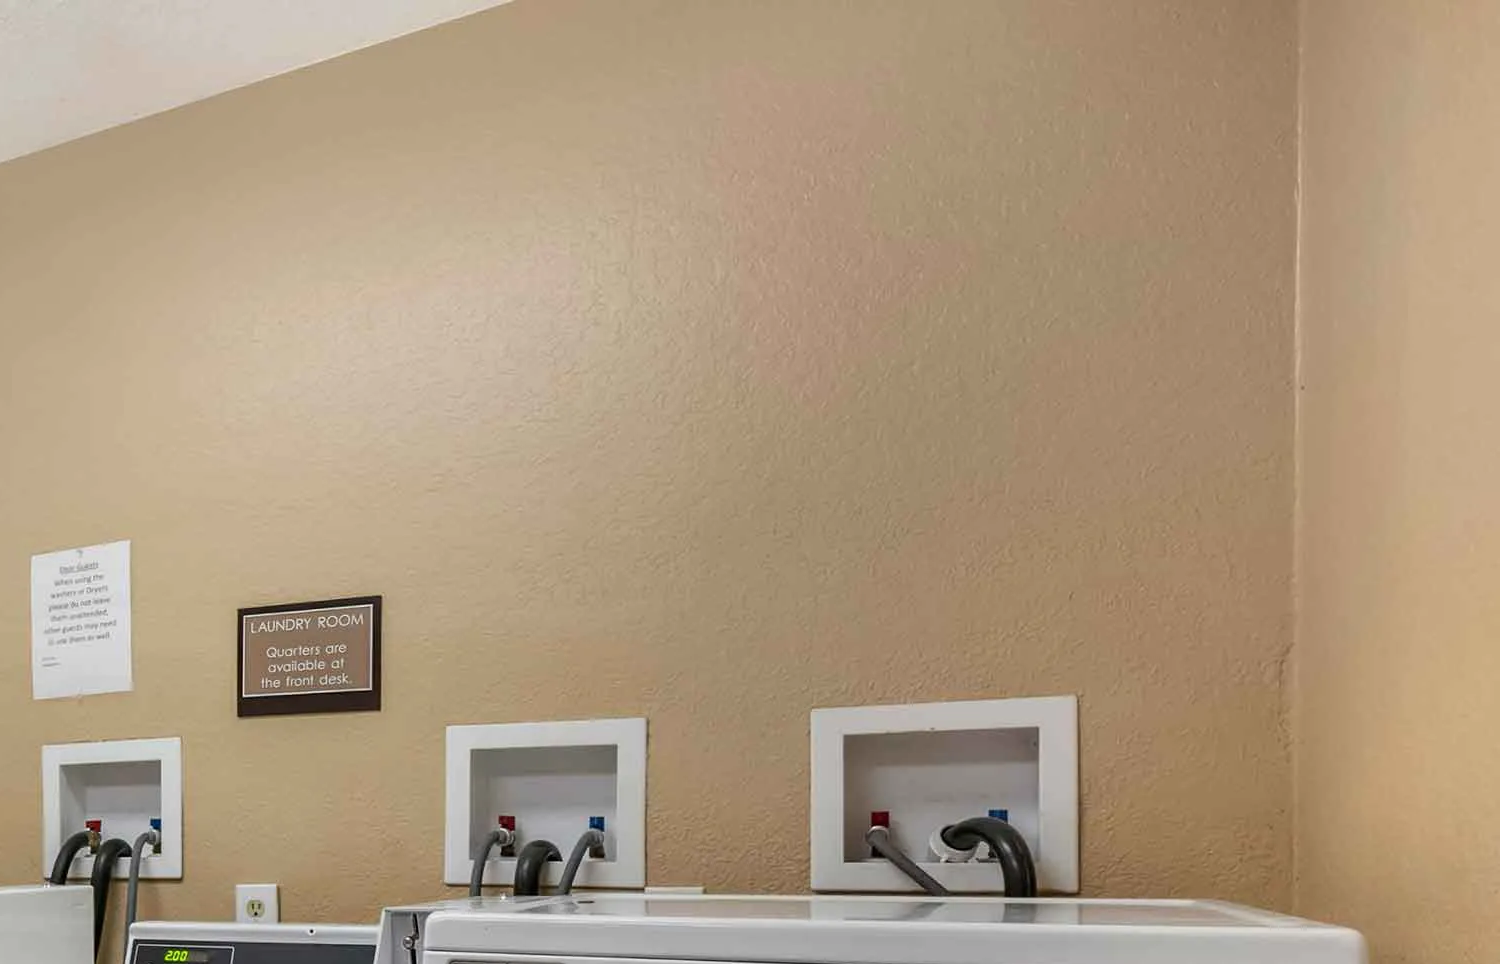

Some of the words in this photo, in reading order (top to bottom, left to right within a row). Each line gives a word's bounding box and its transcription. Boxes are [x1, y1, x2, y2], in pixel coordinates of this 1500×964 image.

[250, 618, 312, 634] LAUNDRY
[317, 613, 364, 629] ROOM
[266, 644, 320, 658] Quarters
[325, 643, 347, 655] are
[267, 659, 325, 673] available
[331, 658, 344, 669] at
[261, 677, 281, 689] the
[286, 674, 314, 687] front
[319, 672, 353, 686] desk.
